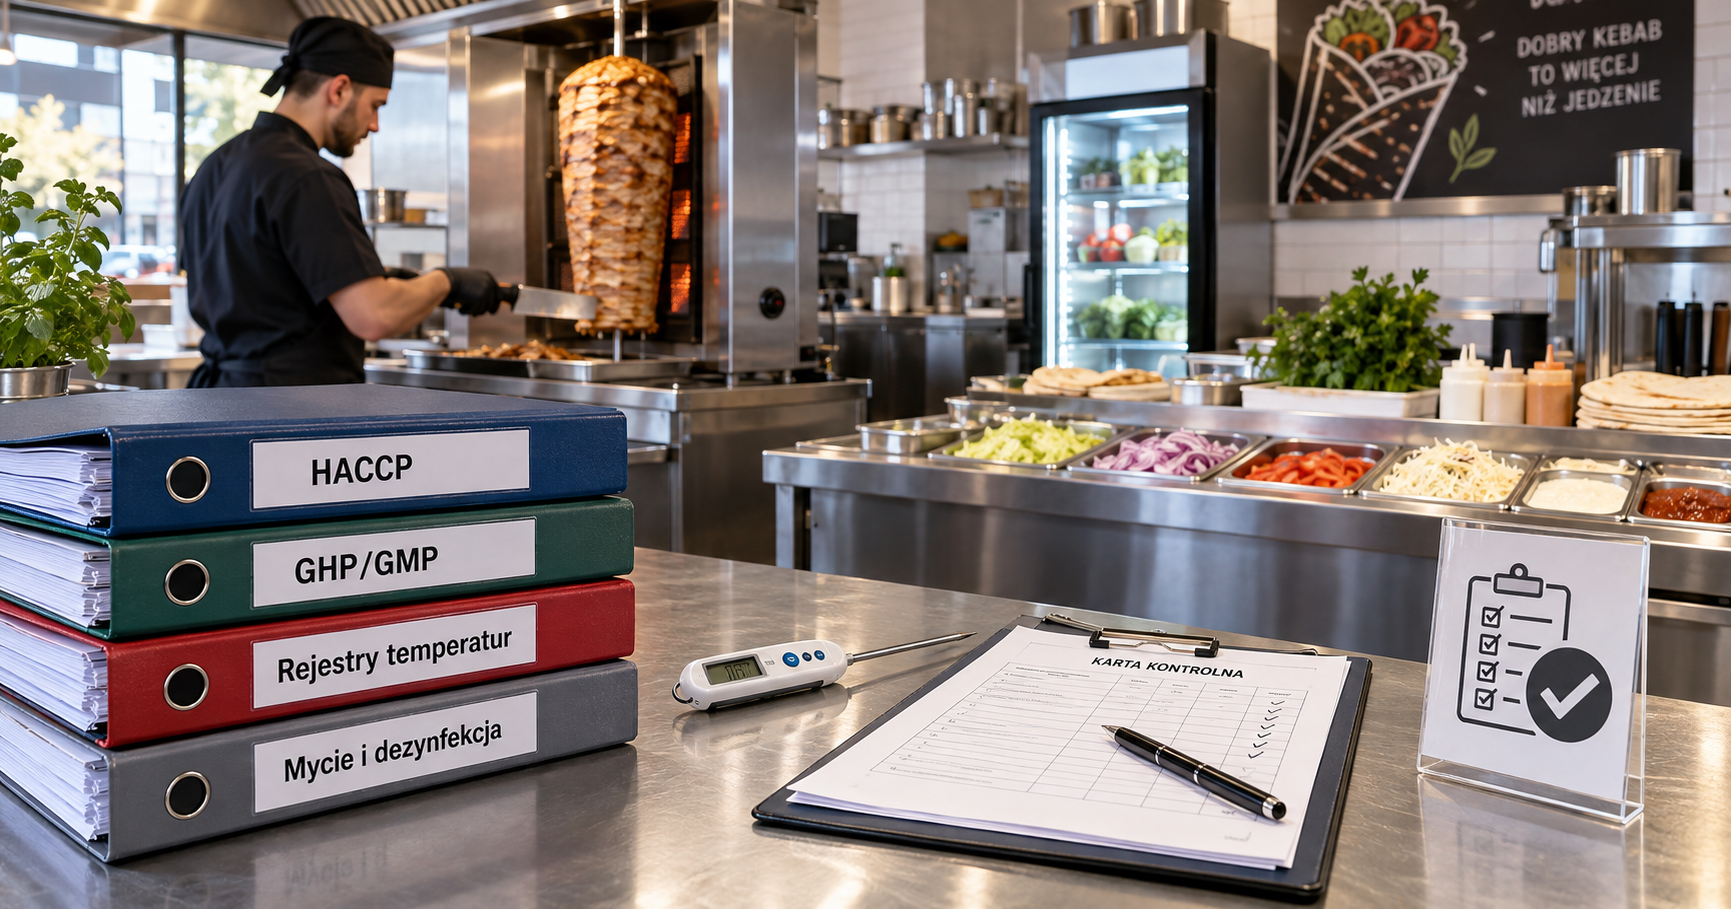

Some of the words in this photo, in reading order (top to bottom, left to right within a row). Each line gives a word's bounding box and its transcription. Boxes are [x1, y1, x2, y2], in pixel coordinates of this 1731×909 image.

[1517, 29, 1586, 58] DOBRY
[1593, 19, 1663, 49] KEBAB
[1528, 63, 1556, 87] TO
[1561, 51, 1639, 83] WIĘCEJ
[1521, 89, 1557, 118] NIŻ
[1562, 79, 1662, 113] JEDZENIE
[311, 454, 413, 486] HACCP
[294, 546, 439, 584] GHP/GMP
[277, 651, 379, 685] Rejestry
[386, 630, 513, 665] temperatur
[1091, 656, 1142, 670] KARTA
[1145, 661, 1245, 679] KONTROLNA
[284, 749, 354, 784] Mycie
[361, 744, 367, 767] i
[374, 719, 502, 763] dezynfekcja
